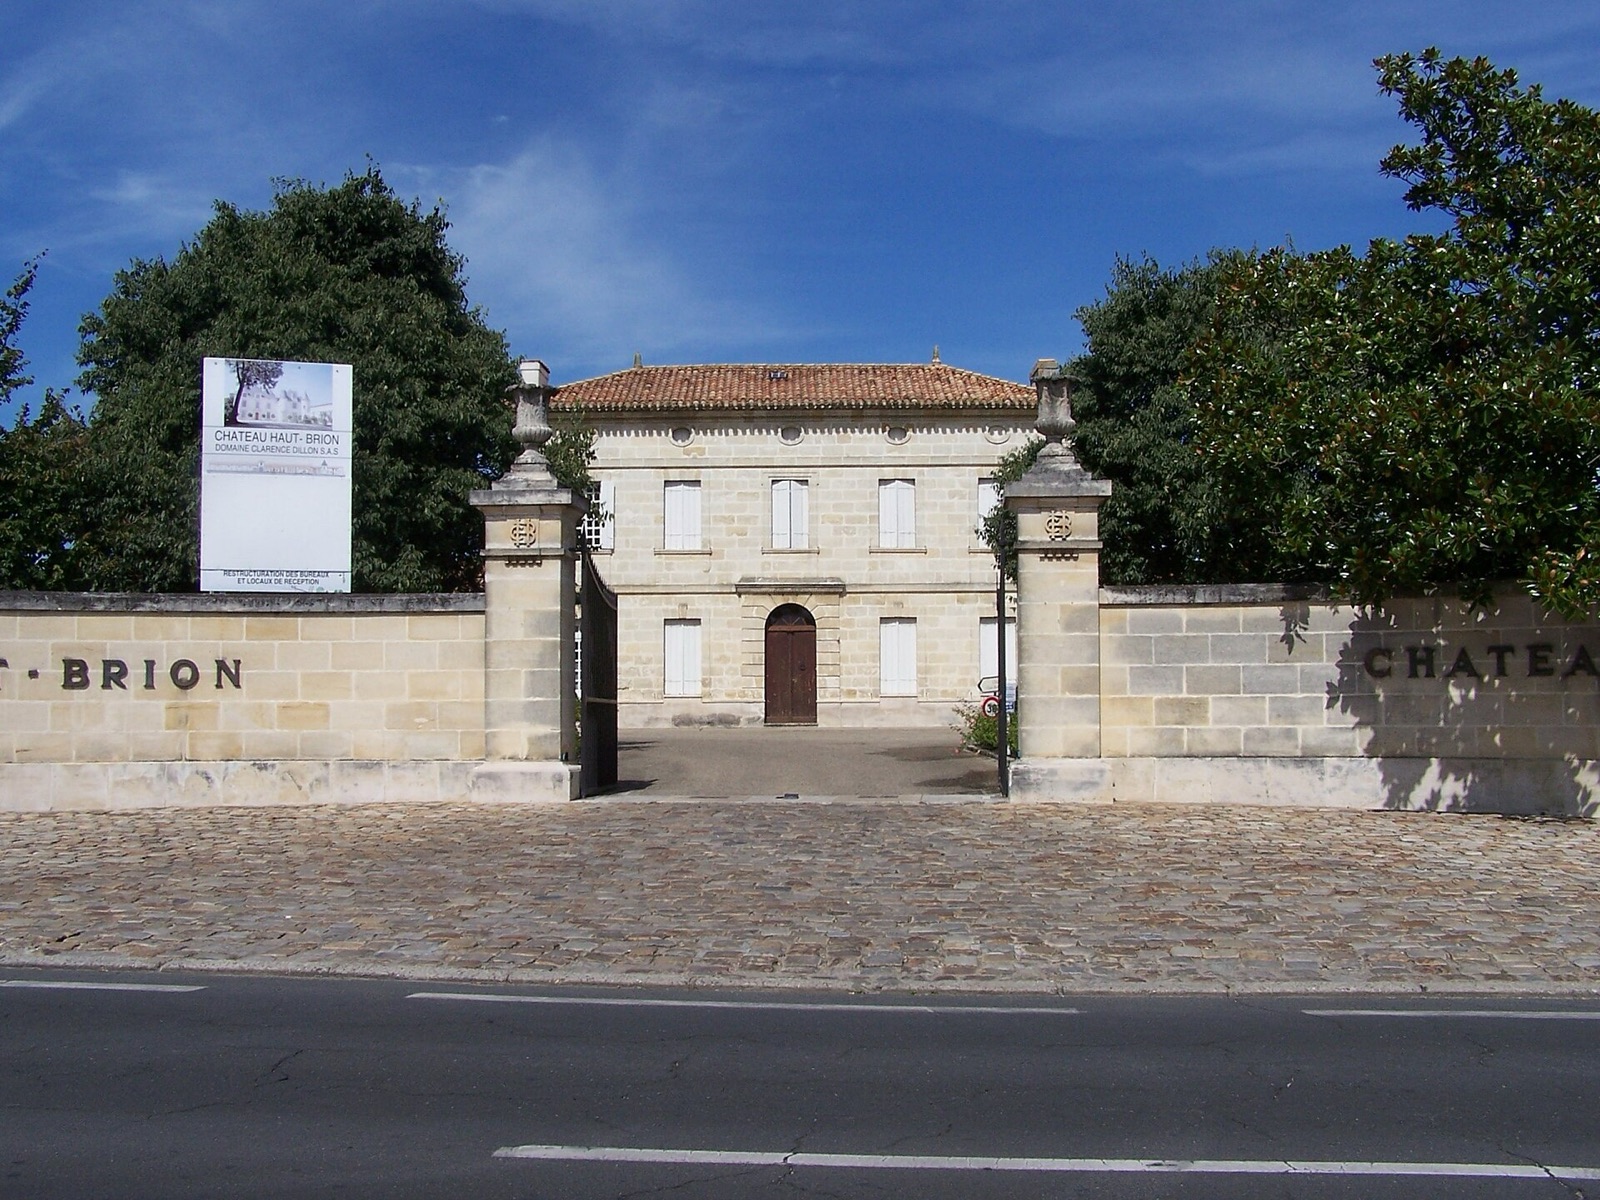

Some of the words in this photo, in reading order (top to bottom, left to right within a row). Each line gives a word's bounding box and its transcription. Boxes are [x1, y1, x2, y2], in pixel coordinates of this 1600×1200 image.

[214, 430, 267, 443] CHATEAU
[306, 433, 340, 446] BRION
[215, 443, 250, 453] DOMAINE
[251, 444, 291, 454] CLARENCE
[292, 446, 319, 455] DILLON
[223, 570, 284, 578] RESTRUCTURATION
[1363, 645, 1600, 679] CHATEA
[61, 658, 243, 690] BRION
